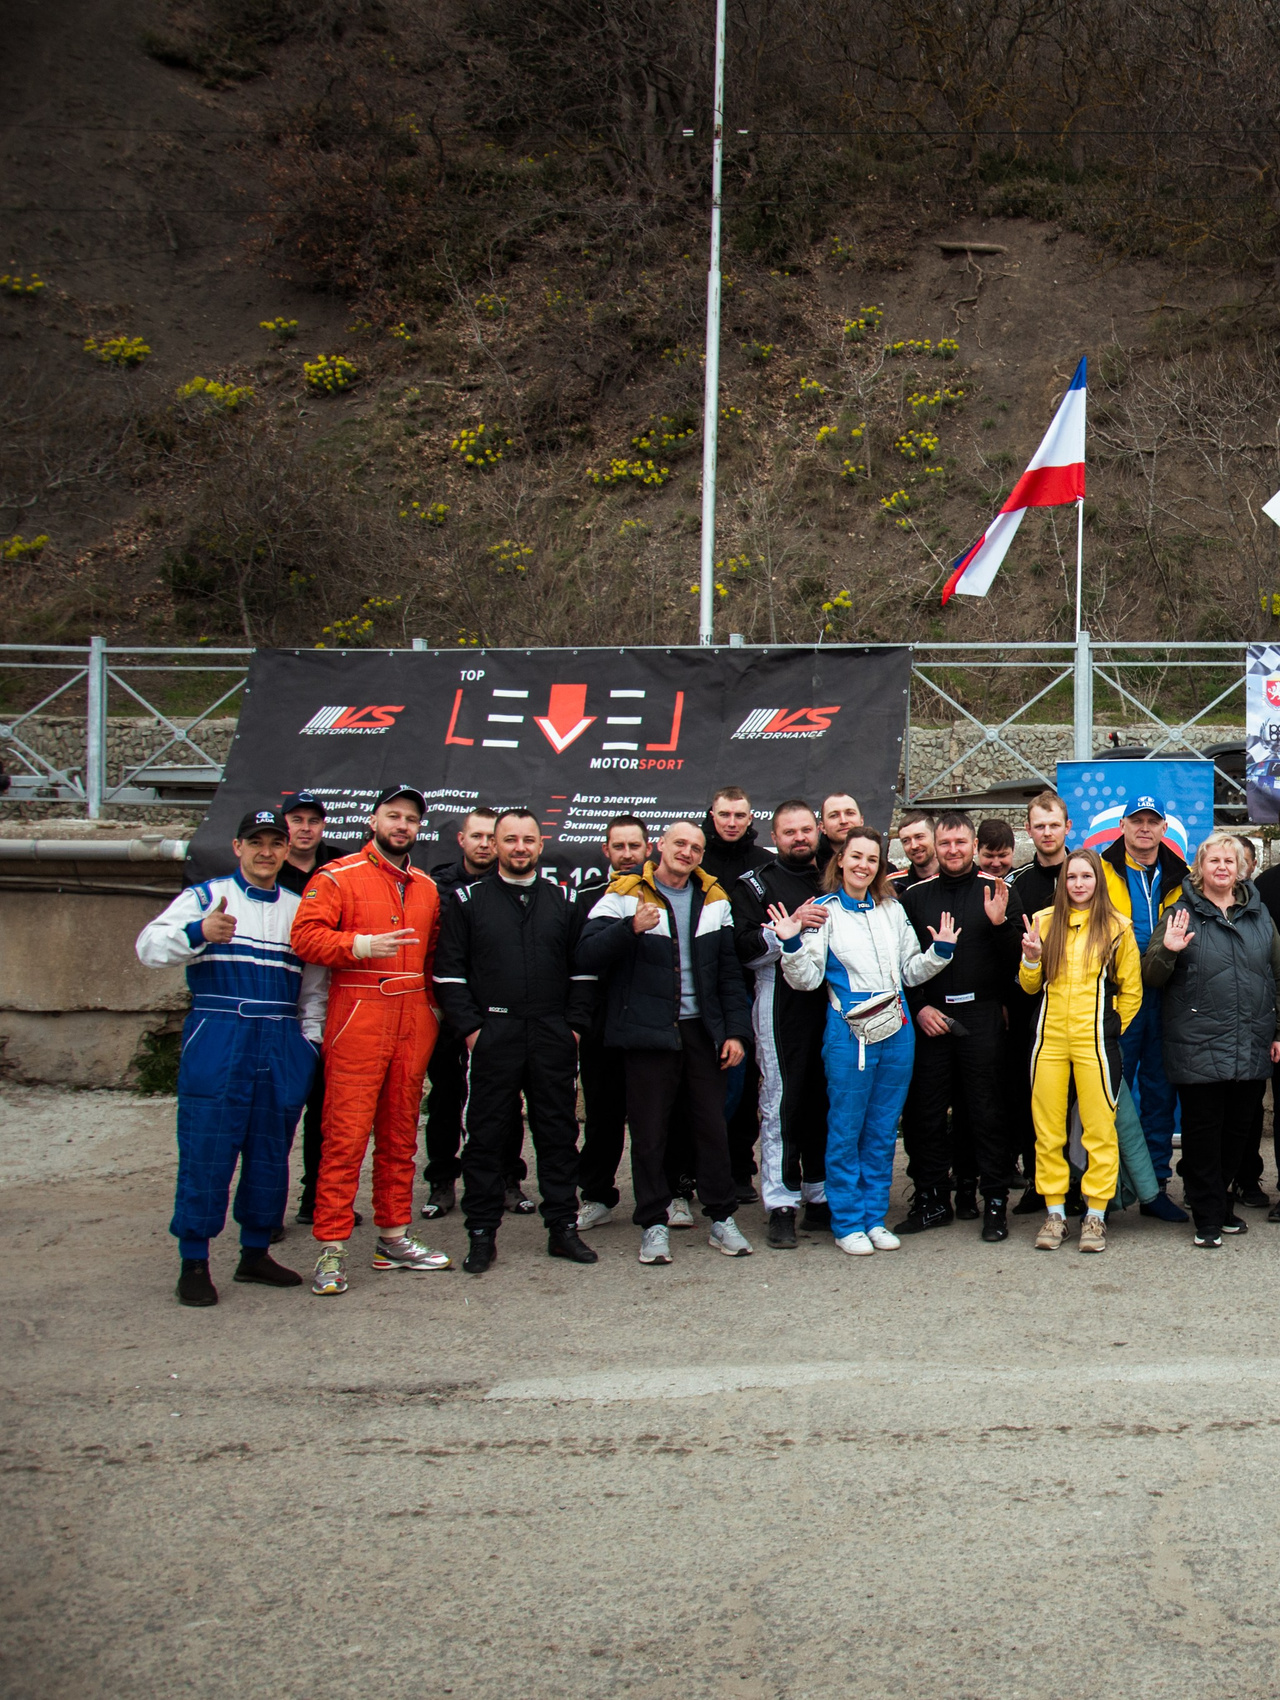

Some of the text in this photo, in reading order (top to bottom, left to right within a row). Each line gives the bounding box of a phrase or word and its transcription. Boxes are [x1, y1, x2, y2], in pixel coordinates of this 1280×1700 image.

[460, 670, 485, 681] TOP
[299, 726, 390, 735] PERFORMANCE
[730, 729, 827, 740] PERFORMANCE
[590, 757, 684, 770] MOTORSPORT
[423, 788, 479, 799] мощности
[572, 793, 658, 806] Авто электрик
[567, 807, 708, 819] Установка дополнитель
